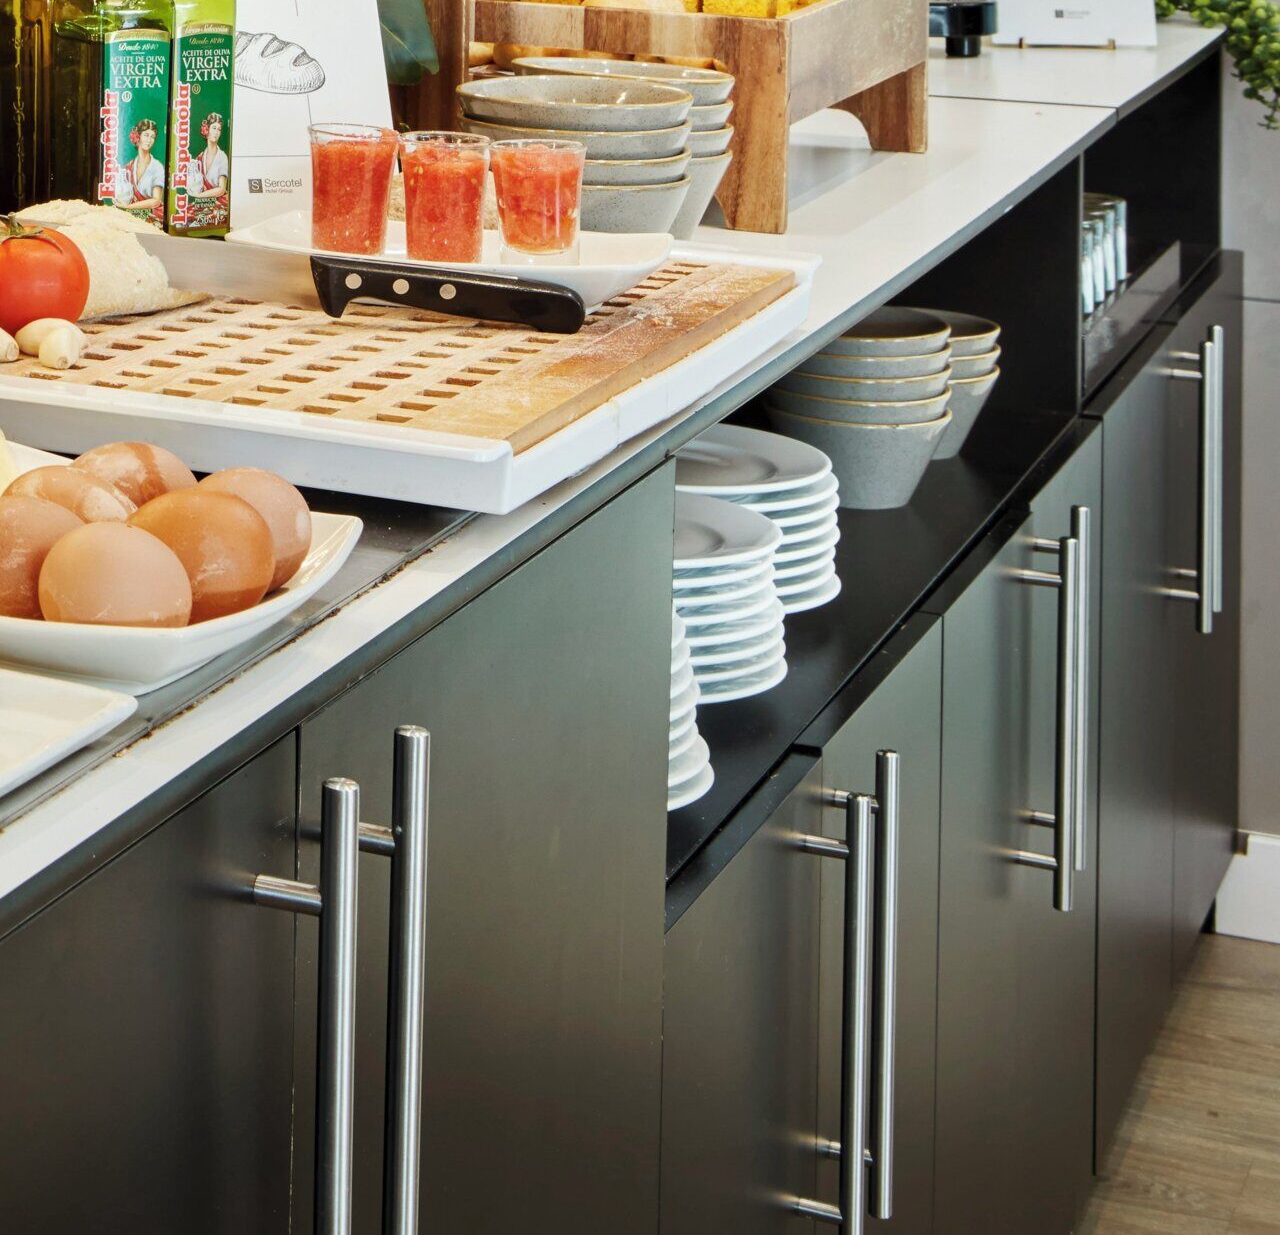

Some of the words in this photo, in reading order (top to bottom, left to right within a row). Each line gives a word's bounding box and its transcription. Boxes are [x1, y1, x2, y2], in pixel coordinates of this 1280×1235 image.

[110, 55, 134, 63] ACEITE
[135, 55, 145, 63] DE
[146, 55, 166, 63] OLIVA
[181, 49, 203, 57] ACEITE
[213, 48, 231, 56] OLIVA
[182, 55, 230, 69] VIRGEN
[110, 63, 165, 76] VIRGEN
[186, 68, 228, 82] EXTRA
[114, 76, 162, 89] EXTRA
[263, 178, 303, 188] Sercotel
